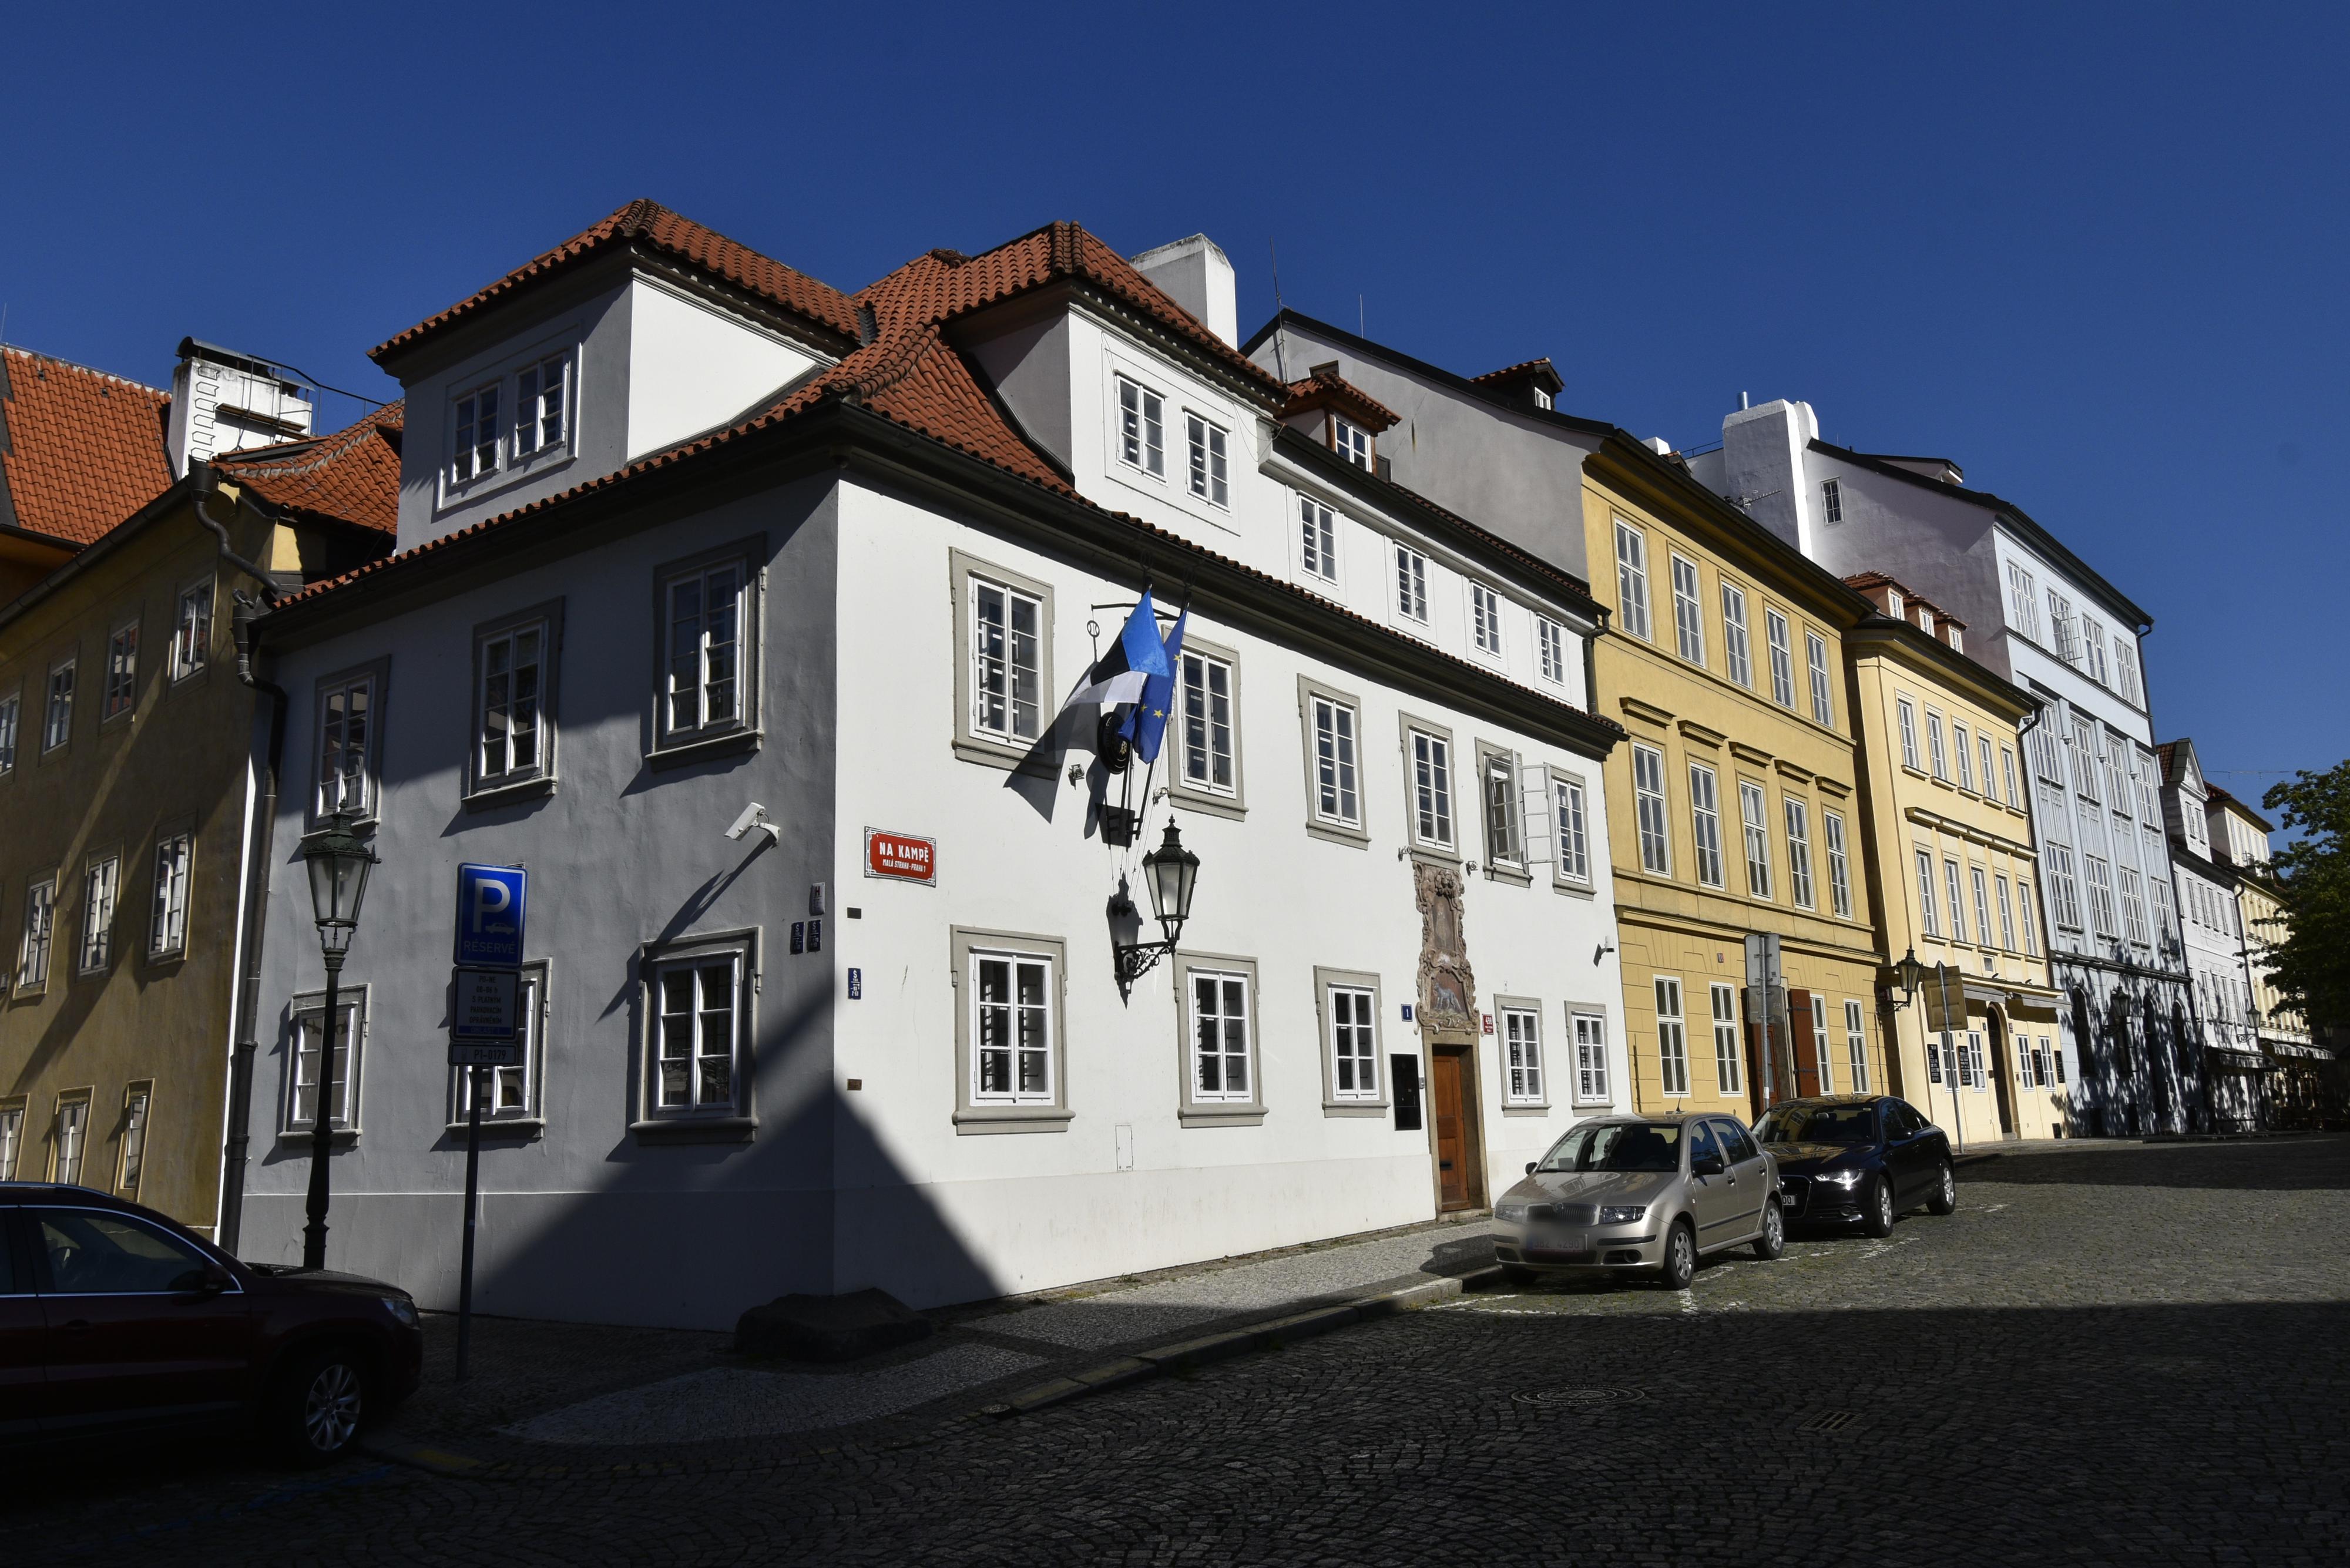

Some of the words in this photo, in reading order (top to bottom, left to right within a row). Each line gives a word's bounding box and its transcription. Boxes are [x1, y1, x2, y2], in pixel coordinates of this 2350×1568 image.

[879, 842, 893, 857] NA
[898, 845, 929, 862] KAMPĚ
[882, 858, 894, 868] MALÁ
[894, 861, 909, 870] STRANA
[911, 863, 924, 872] PRAHA
[472, 878, 511, 933] P
[464, 938, 516, 954] RÉSERVÉ
[479, 975, 496, 983] PO-NE
[478, 995, 501, 1003] PLATNÝM
[470, 1005, 502, 1013] PARKOVACÍM
[1406, 1009, 1409, 1018] 1
[469, 1015, 502, 1025] OPRÁVNĚNÍM
[474, 1049, 506, 1060] P1-0179
